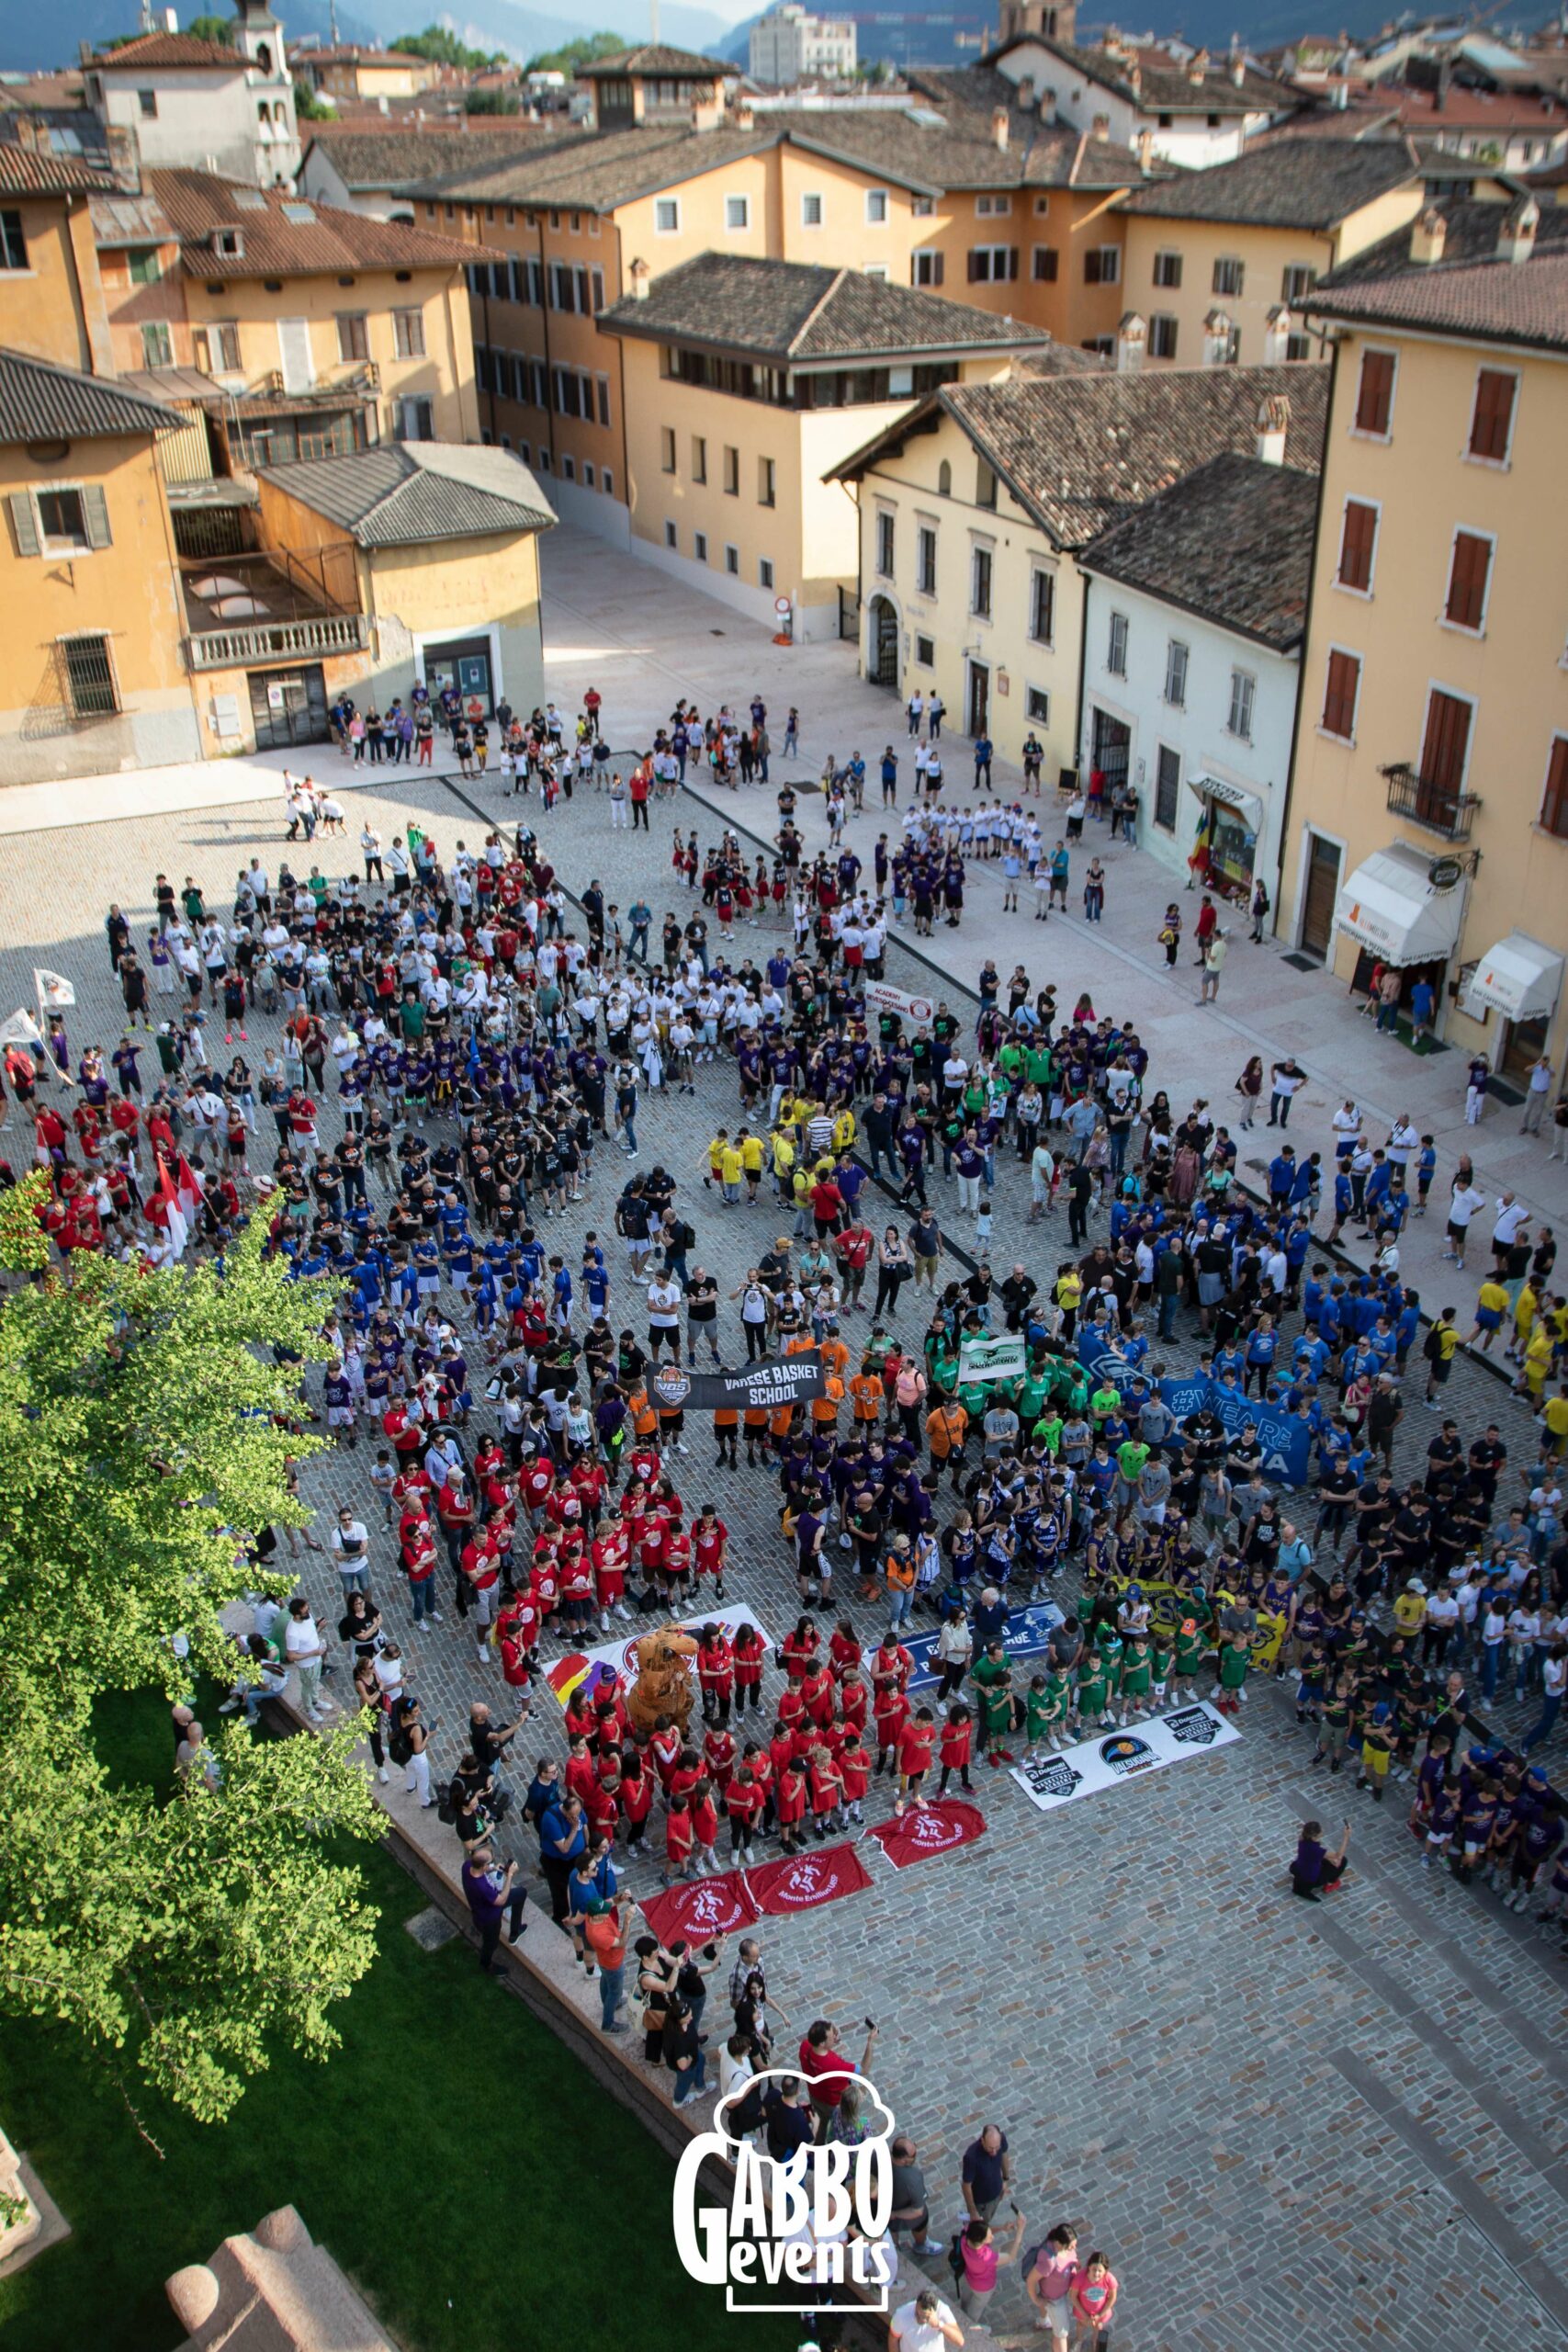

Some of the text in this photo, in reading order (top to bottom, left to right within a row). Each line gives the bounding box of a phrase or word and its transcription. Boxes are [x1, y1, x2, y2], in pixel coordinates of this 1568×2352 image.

[724, 1364, 818, 1391] VARESE BASKET
[749, 1384, 798, 1406] SCHOOL
[1038, 1761, 1066, 1776] Dolomiti
[1111, 1750, 1162, 1775] VALSUGANA
[1035, 1772, 1077, 1789] BASKETBALL
[778, 1873, 839, 1902] Monte Emilius UISP
[683, 1922, 711, 1933] Monte
[730, 1904, 742, 1919] UISP
